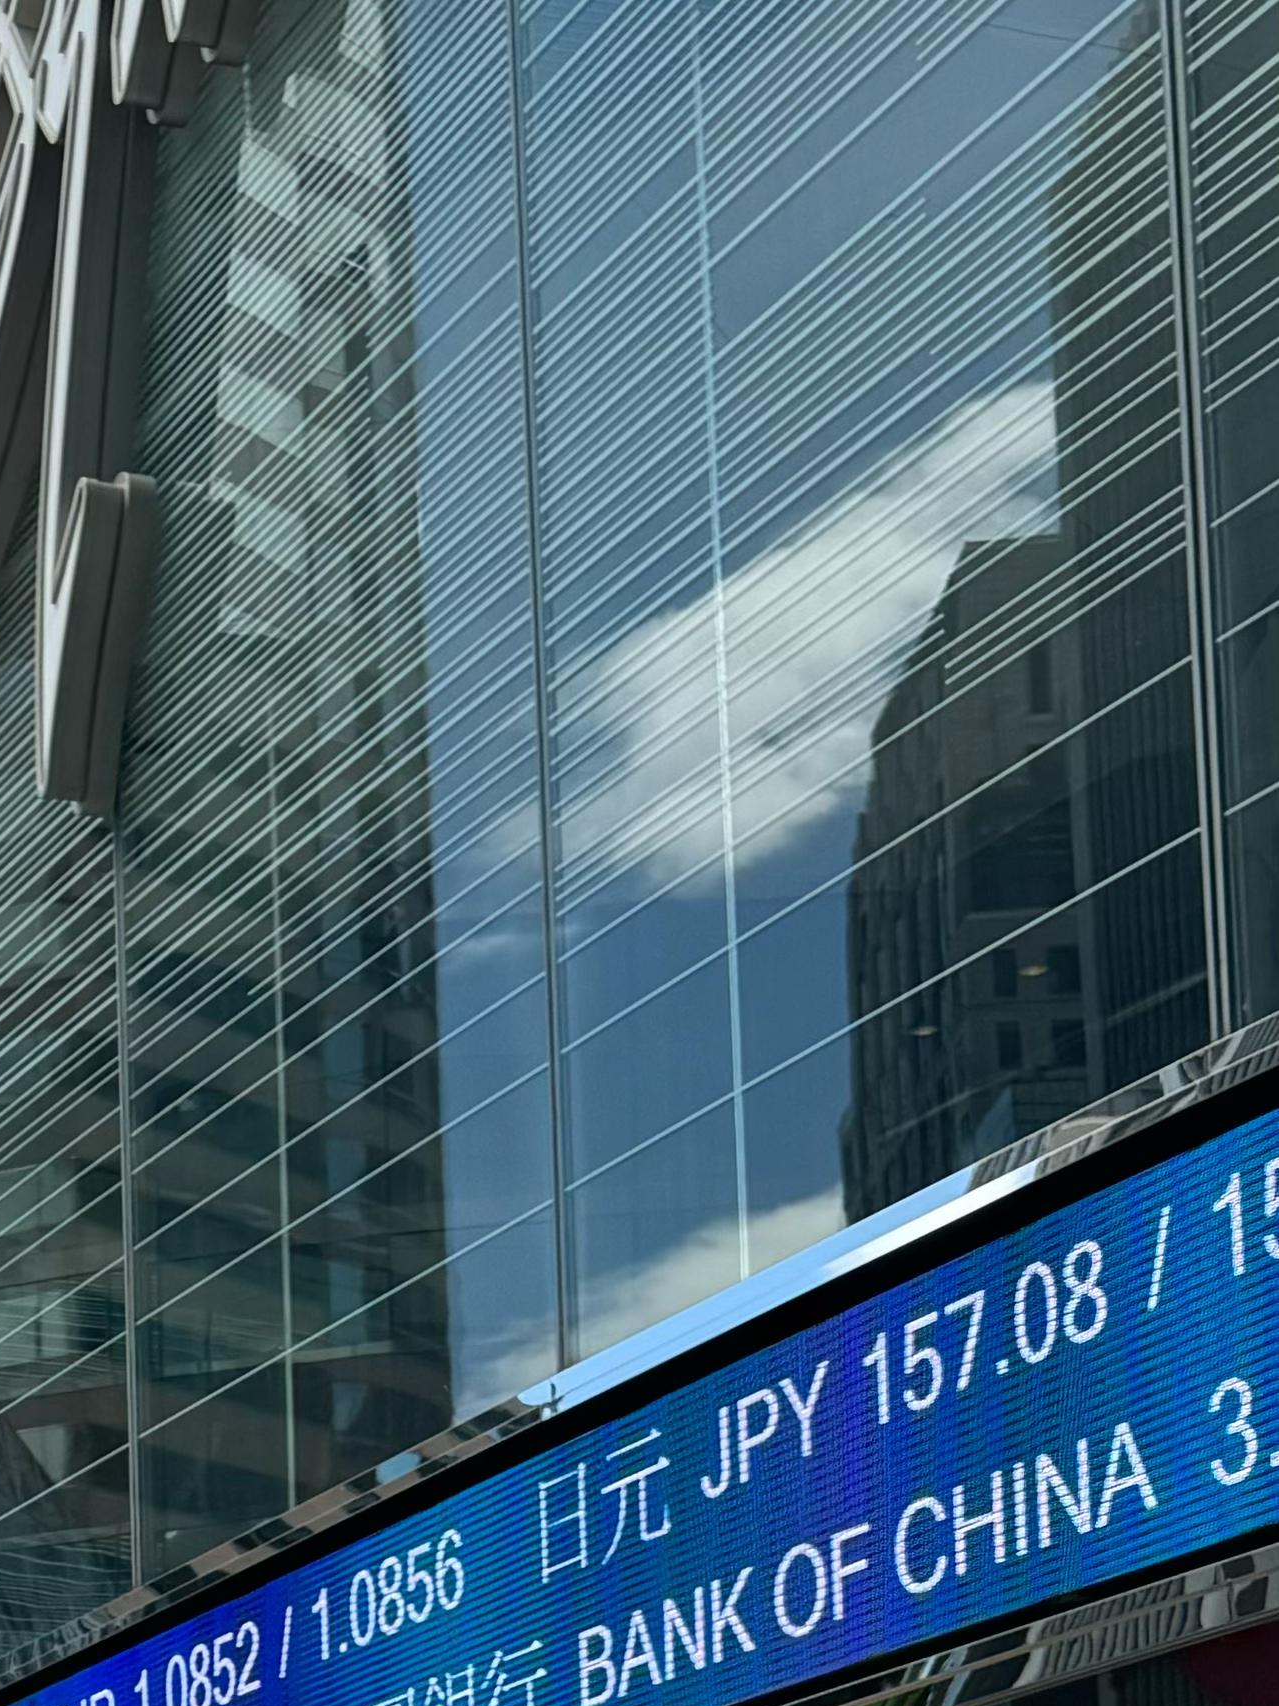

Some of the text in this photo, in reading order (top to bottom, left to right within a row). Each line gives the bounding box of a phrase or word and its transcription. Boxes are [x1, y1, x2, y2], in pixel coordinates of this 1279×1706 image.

[310, 1529, 466, 1660] 1.0856
[536, 1427, 674, 1585] 日元
[699, 1361, 830, 1500] JPY
[862, 1239, 1109, 1426] 157.08
[773, 1524, 870, 1640] OF
[893, 1422, 1160, 1595] CHINA
